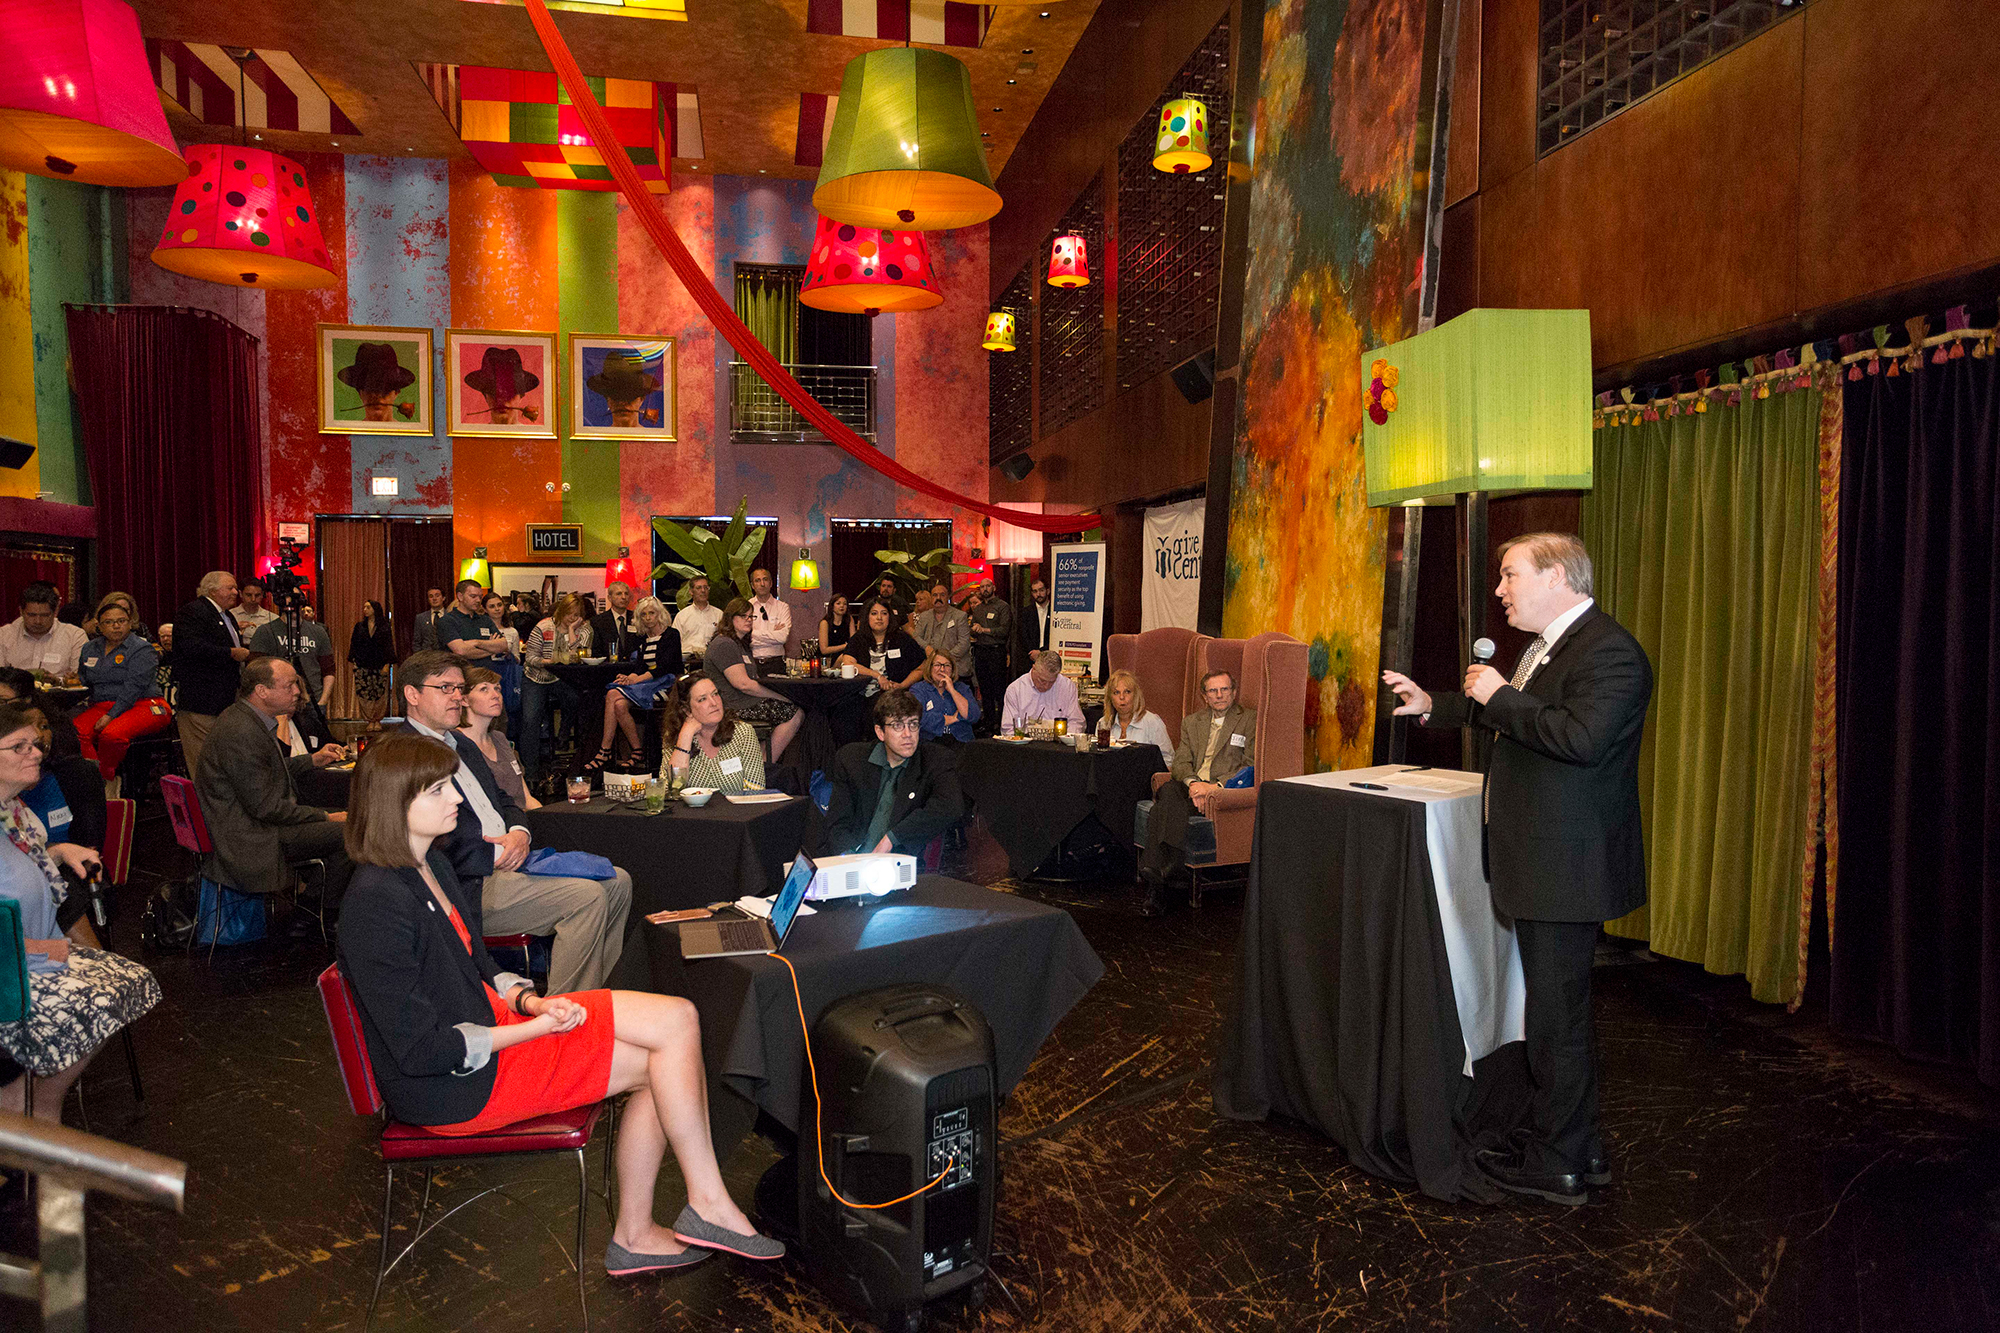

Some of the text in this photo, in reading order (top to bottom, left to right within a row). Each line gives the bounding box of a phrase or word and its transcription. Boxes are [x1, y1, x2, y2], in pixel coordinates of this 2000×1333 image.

[534, 532, 576, 548] HOTEL
[1173, 530, 1199, 558] give
[1058, 558, 1078, 570] 66%
